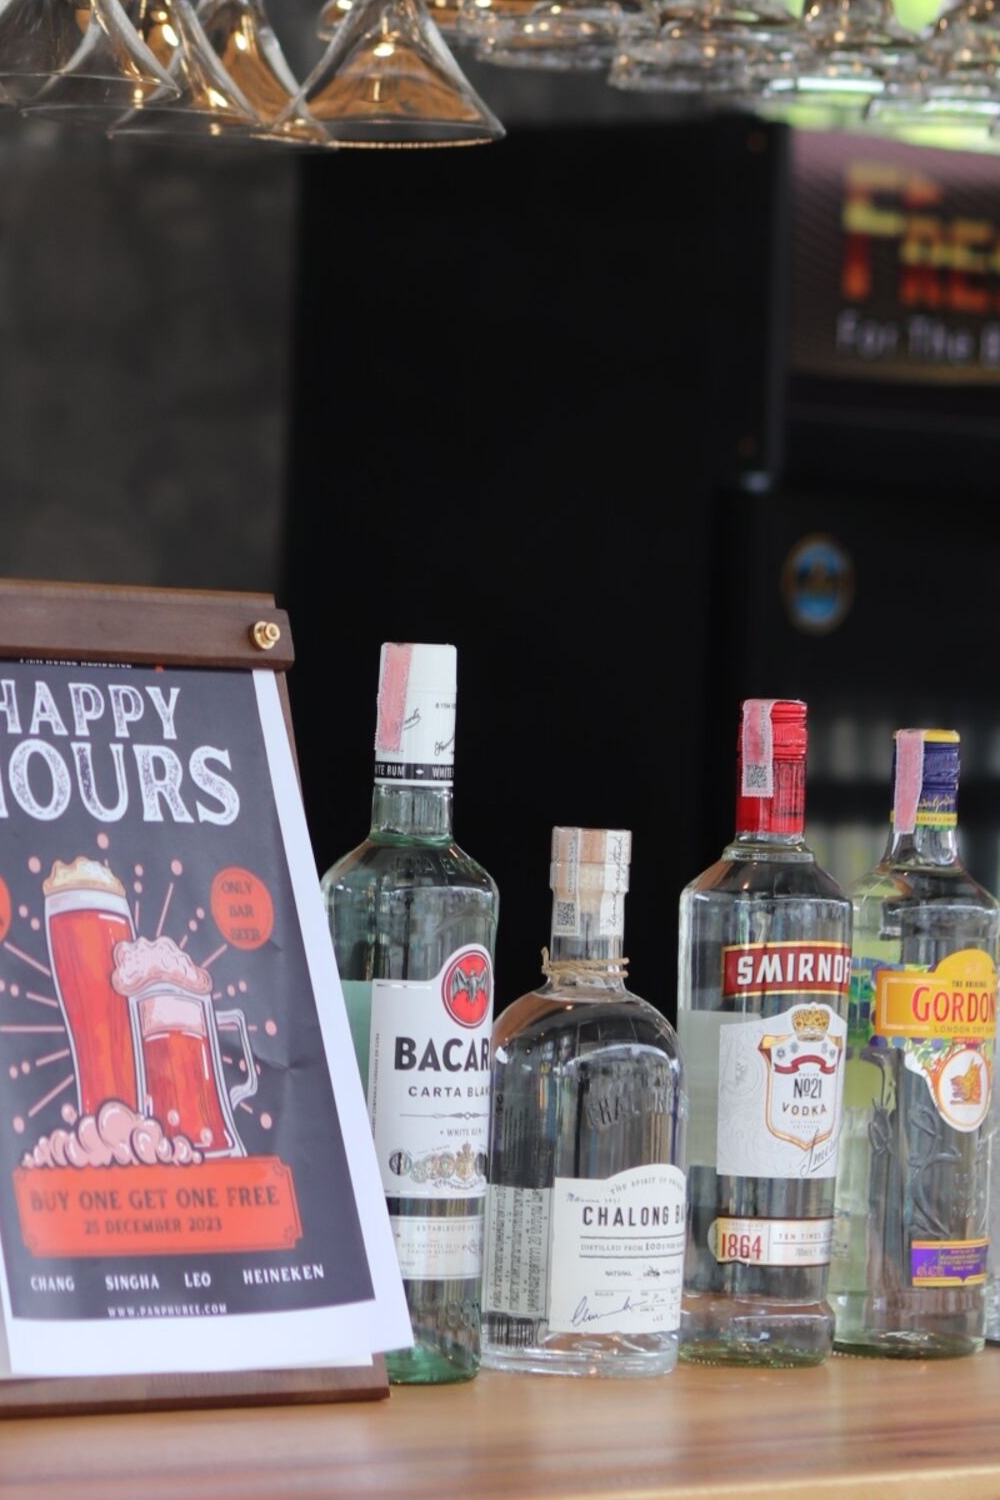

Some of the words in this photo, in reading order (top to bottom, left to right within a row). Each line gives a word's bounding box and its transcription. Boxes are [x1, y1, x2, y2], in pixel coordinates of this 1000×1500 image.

[387, 764, 405, 777] RUM
[221, 881, 252, 894] ONLY
[228, 904, 254, 917] BAR
[230, 927, 261, 941] BEER
[737, 953, 851, 985] SMIRNOF
[408, 1085, 462, 1098] CARTA
[782, 1102, 827, 1117] VODKA
[631, 1177, 656, 1188] SPIRIT
[30, 1190, 69, 1212] BUY
[79, 1188, 120, 1211] ONE
[128, 1188, 168, 1210] GET
[175, 1186, 219, 1209] ONE
[226, 1185, 280, 1207] FREE
[582, 1205, 669, 1227] CHALONG
[675, 1204, 684, 1225] B
[105, 1218, 182, 1234] DECEMBER
[188, 1217, 222, 1232] 2023
[721, 1233, 762, 1260] 1864
[30, 1275, 75, 1292] CHANG
[105, 1274, 160, 1291] SINGHA
[184, 1272, 212, 1288] LEO
[242, 1264, 325, 1285] HEINEKEN
